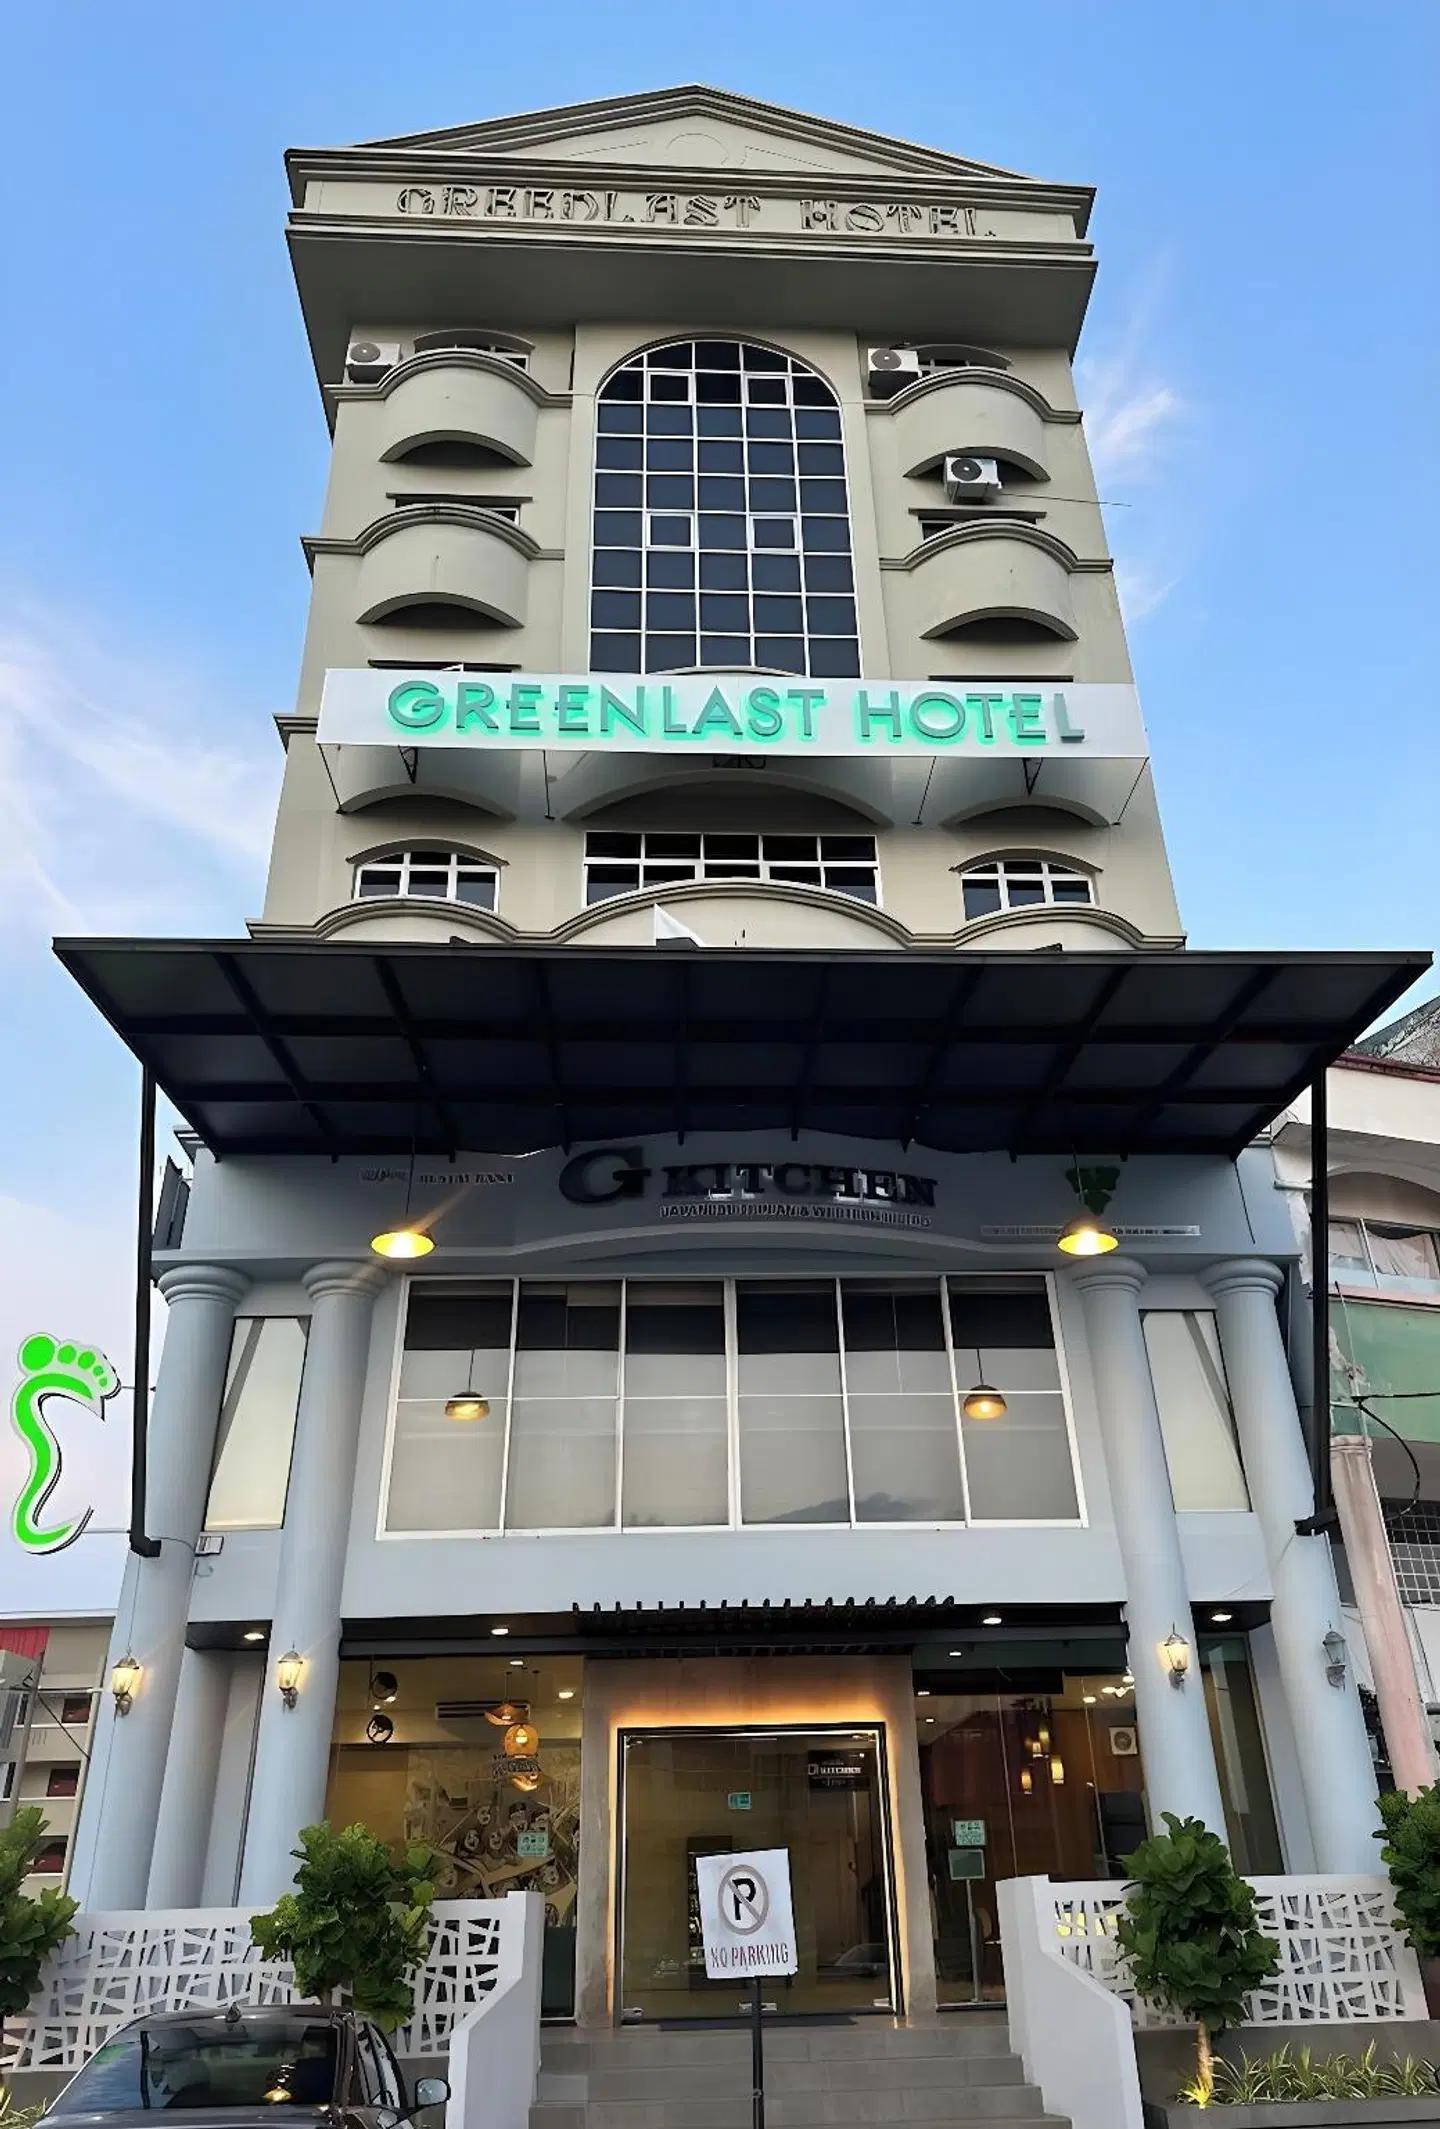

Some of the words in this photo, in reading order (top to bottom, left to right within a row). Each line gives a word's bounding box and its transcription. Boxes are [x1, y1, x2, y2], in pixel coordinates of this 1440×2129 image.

[800, 199, 997, 237] HOTEL
[387, 679, 825, 738] GREENLAST
[857, 689, 1085, 744] HOTEL
[559, 1146, 652, 1205] G
[661, 1162, 940, 1207] KITCHEN
[732, 1877, 756, 1921] P
[710, 1947, 728, 1969] NO
[731, 1943, 789, 1969] PARKING
